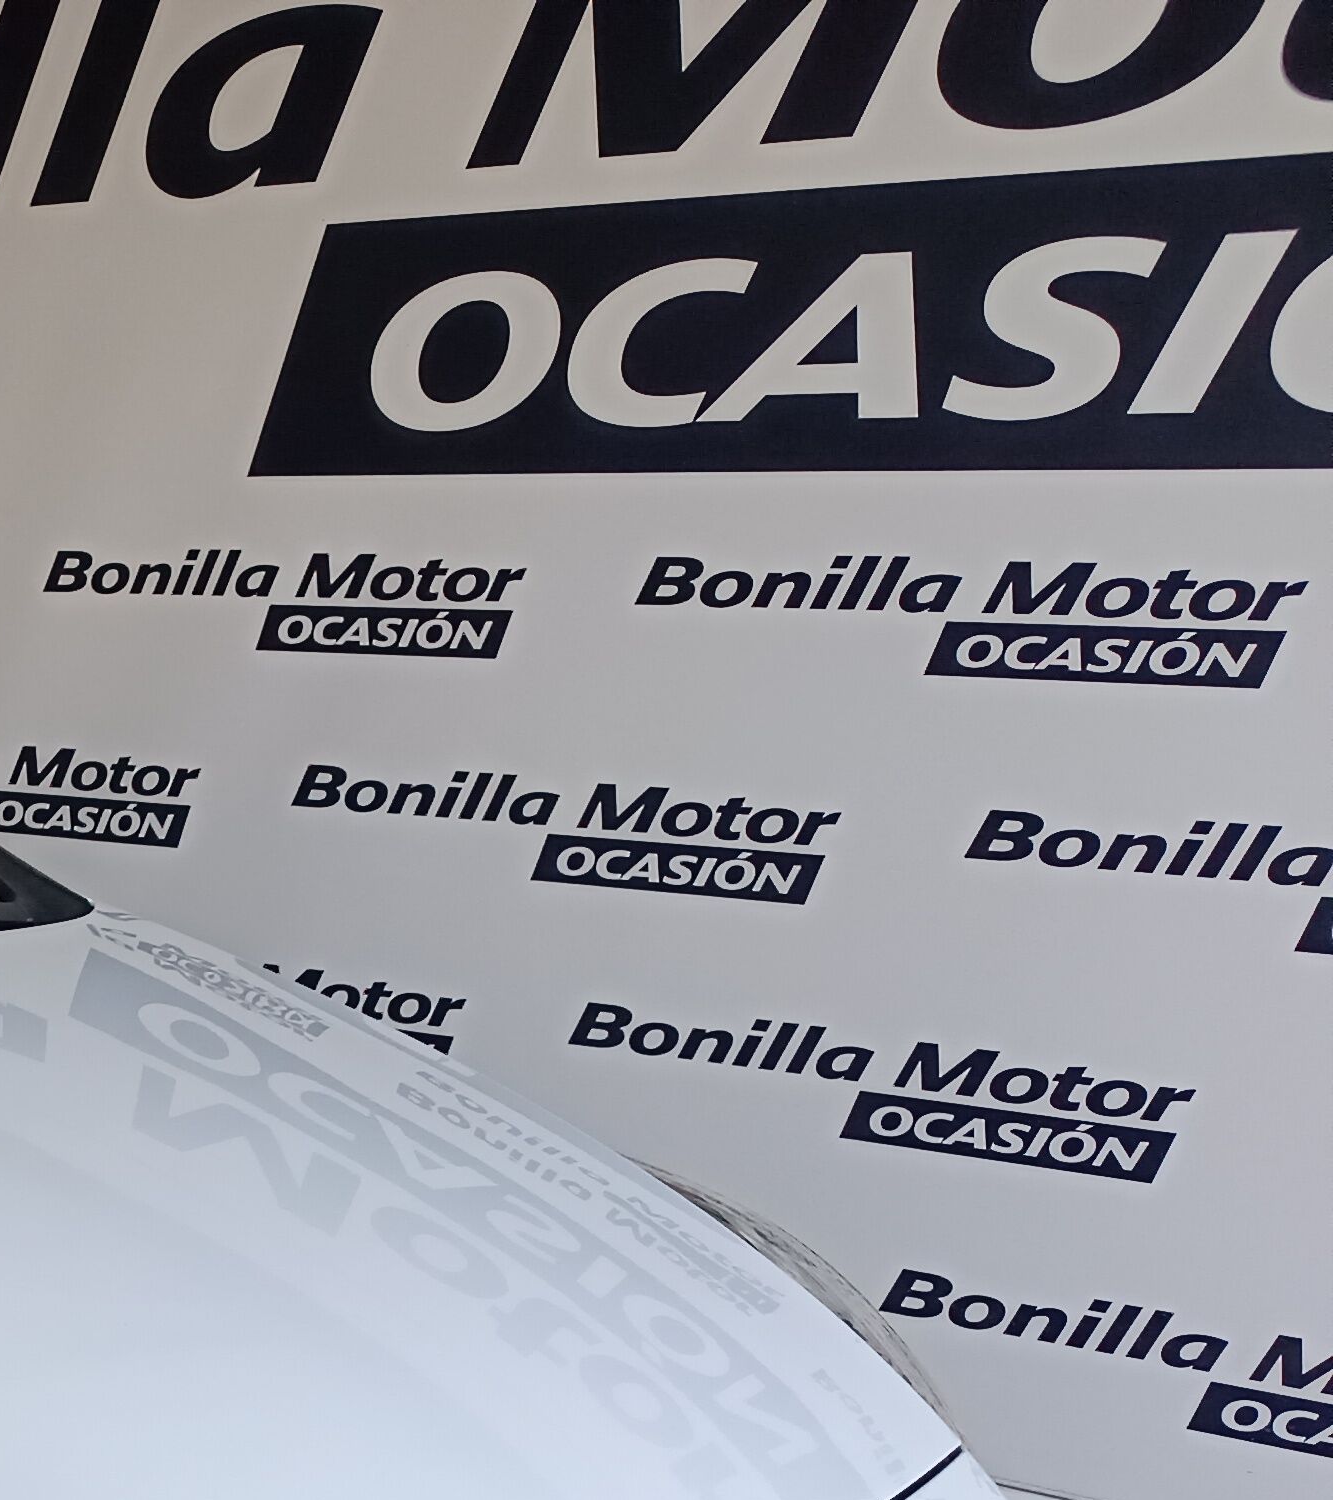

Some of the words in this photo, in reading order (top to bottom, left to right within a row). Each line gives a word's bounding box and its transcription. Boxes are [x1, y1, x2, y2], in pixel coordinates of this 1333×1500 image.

[43, 549, 279, 598] Bonilla
[296, 552, 527, 602] Motor
[634, 556, 963, 613] Bonilla
[981, 560, 1310, 621] Motor
[277, 611, 493, 650] OCASIÓN
[955, 632, 1257, 678] OCASIÓN
[8, 745, 200, 798] Motor
[290, 764, 560, 828] Bonilla
[577, 783, 841, 846] Motor
[556, 846, 802, 895] OCASIÓN
[964, 809, 1333, 887] Bonilla
[568, 1002, 874, 1082] Bonilla
[894, 1042, 1196, 1122] Motor
[869, 1104, 1150, 1172] OCASIÓN
[879, 1268, 1229, 1372] Bonilla
